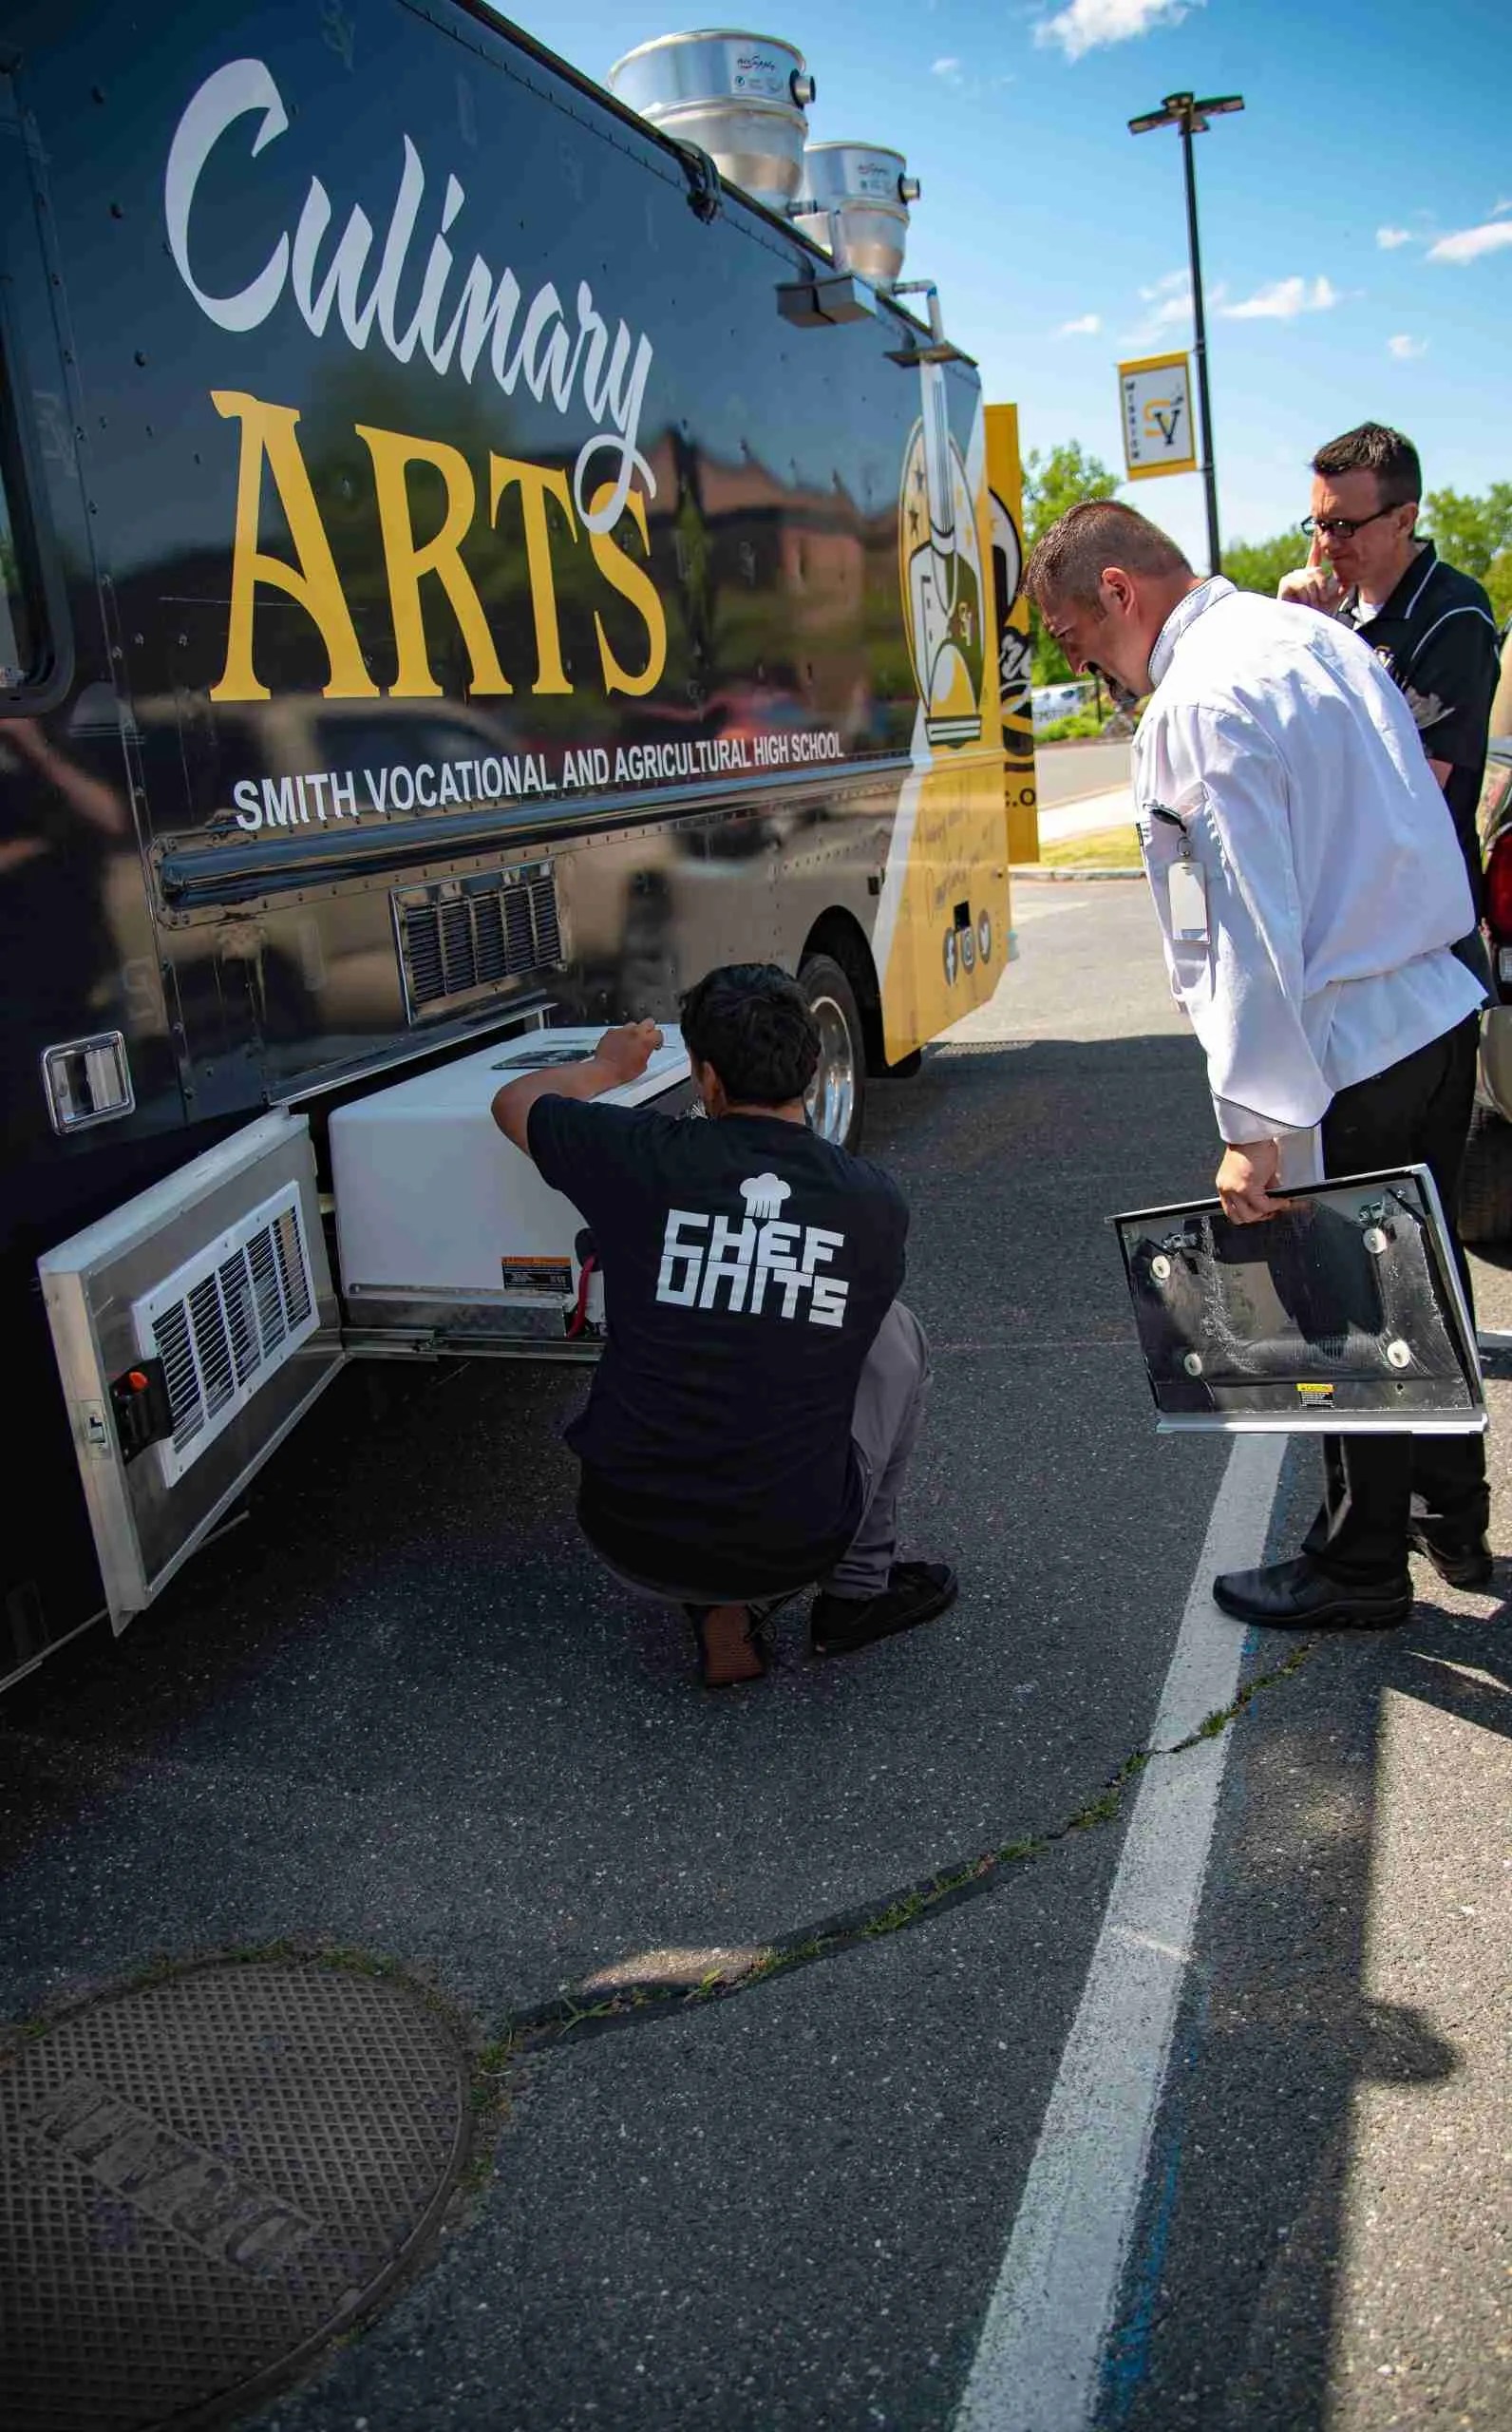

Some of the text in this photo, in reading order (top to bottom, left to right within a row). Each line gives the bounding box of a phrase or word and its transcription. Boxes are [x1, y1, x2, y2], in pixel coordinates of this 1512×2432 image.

[165, 58, 657, 534] Culinary
[210, 390, 668, 701] ARTS
[234, 731, 844, 831] SMITH VOCATIONAL AND AGRICULTURAL HIGH SCHOOL
[655, 1255, 850, 1328] UNITS
[663, 1208, 845, 1275] CHEF
